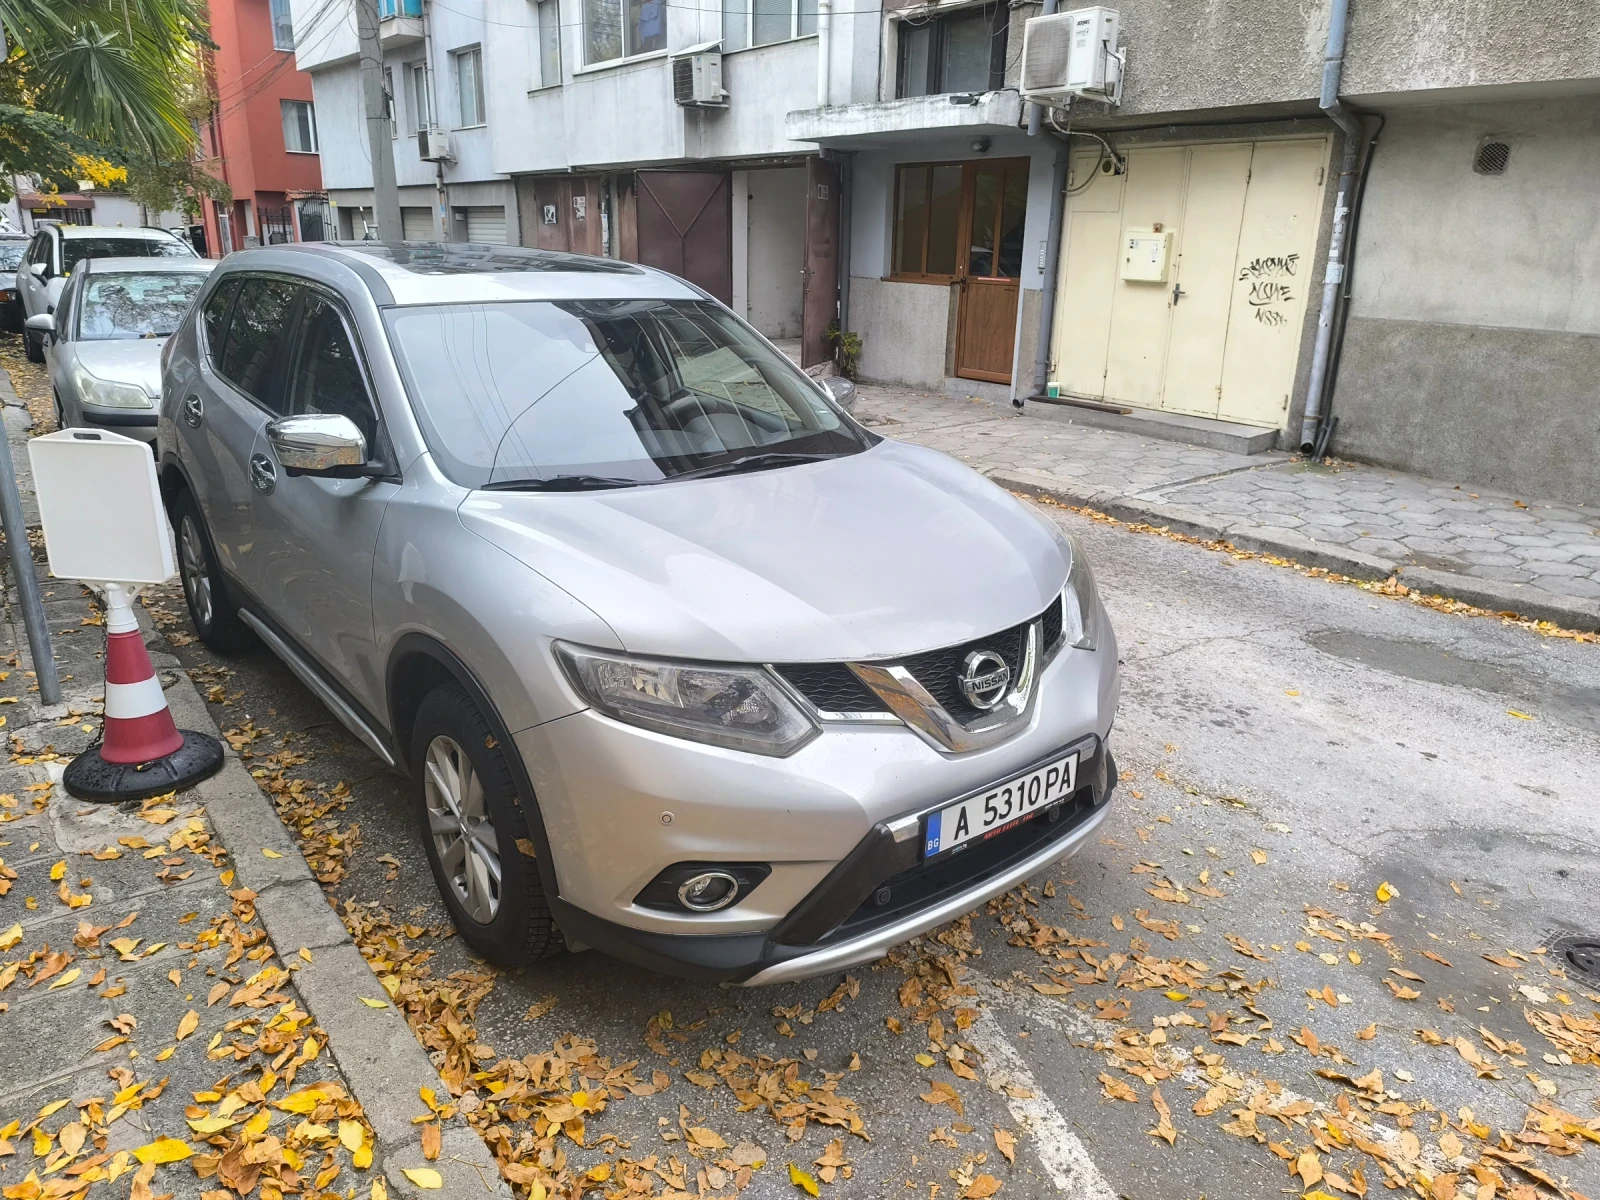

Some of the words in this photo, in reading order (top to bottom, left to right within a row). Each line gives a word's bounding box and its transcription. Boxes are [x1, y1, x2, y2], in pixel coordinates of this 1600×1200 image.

[972, 672, 1008, 691] NISSAN
[953, 805, 970, 841] A
[927, 837, 939, 851] BG
